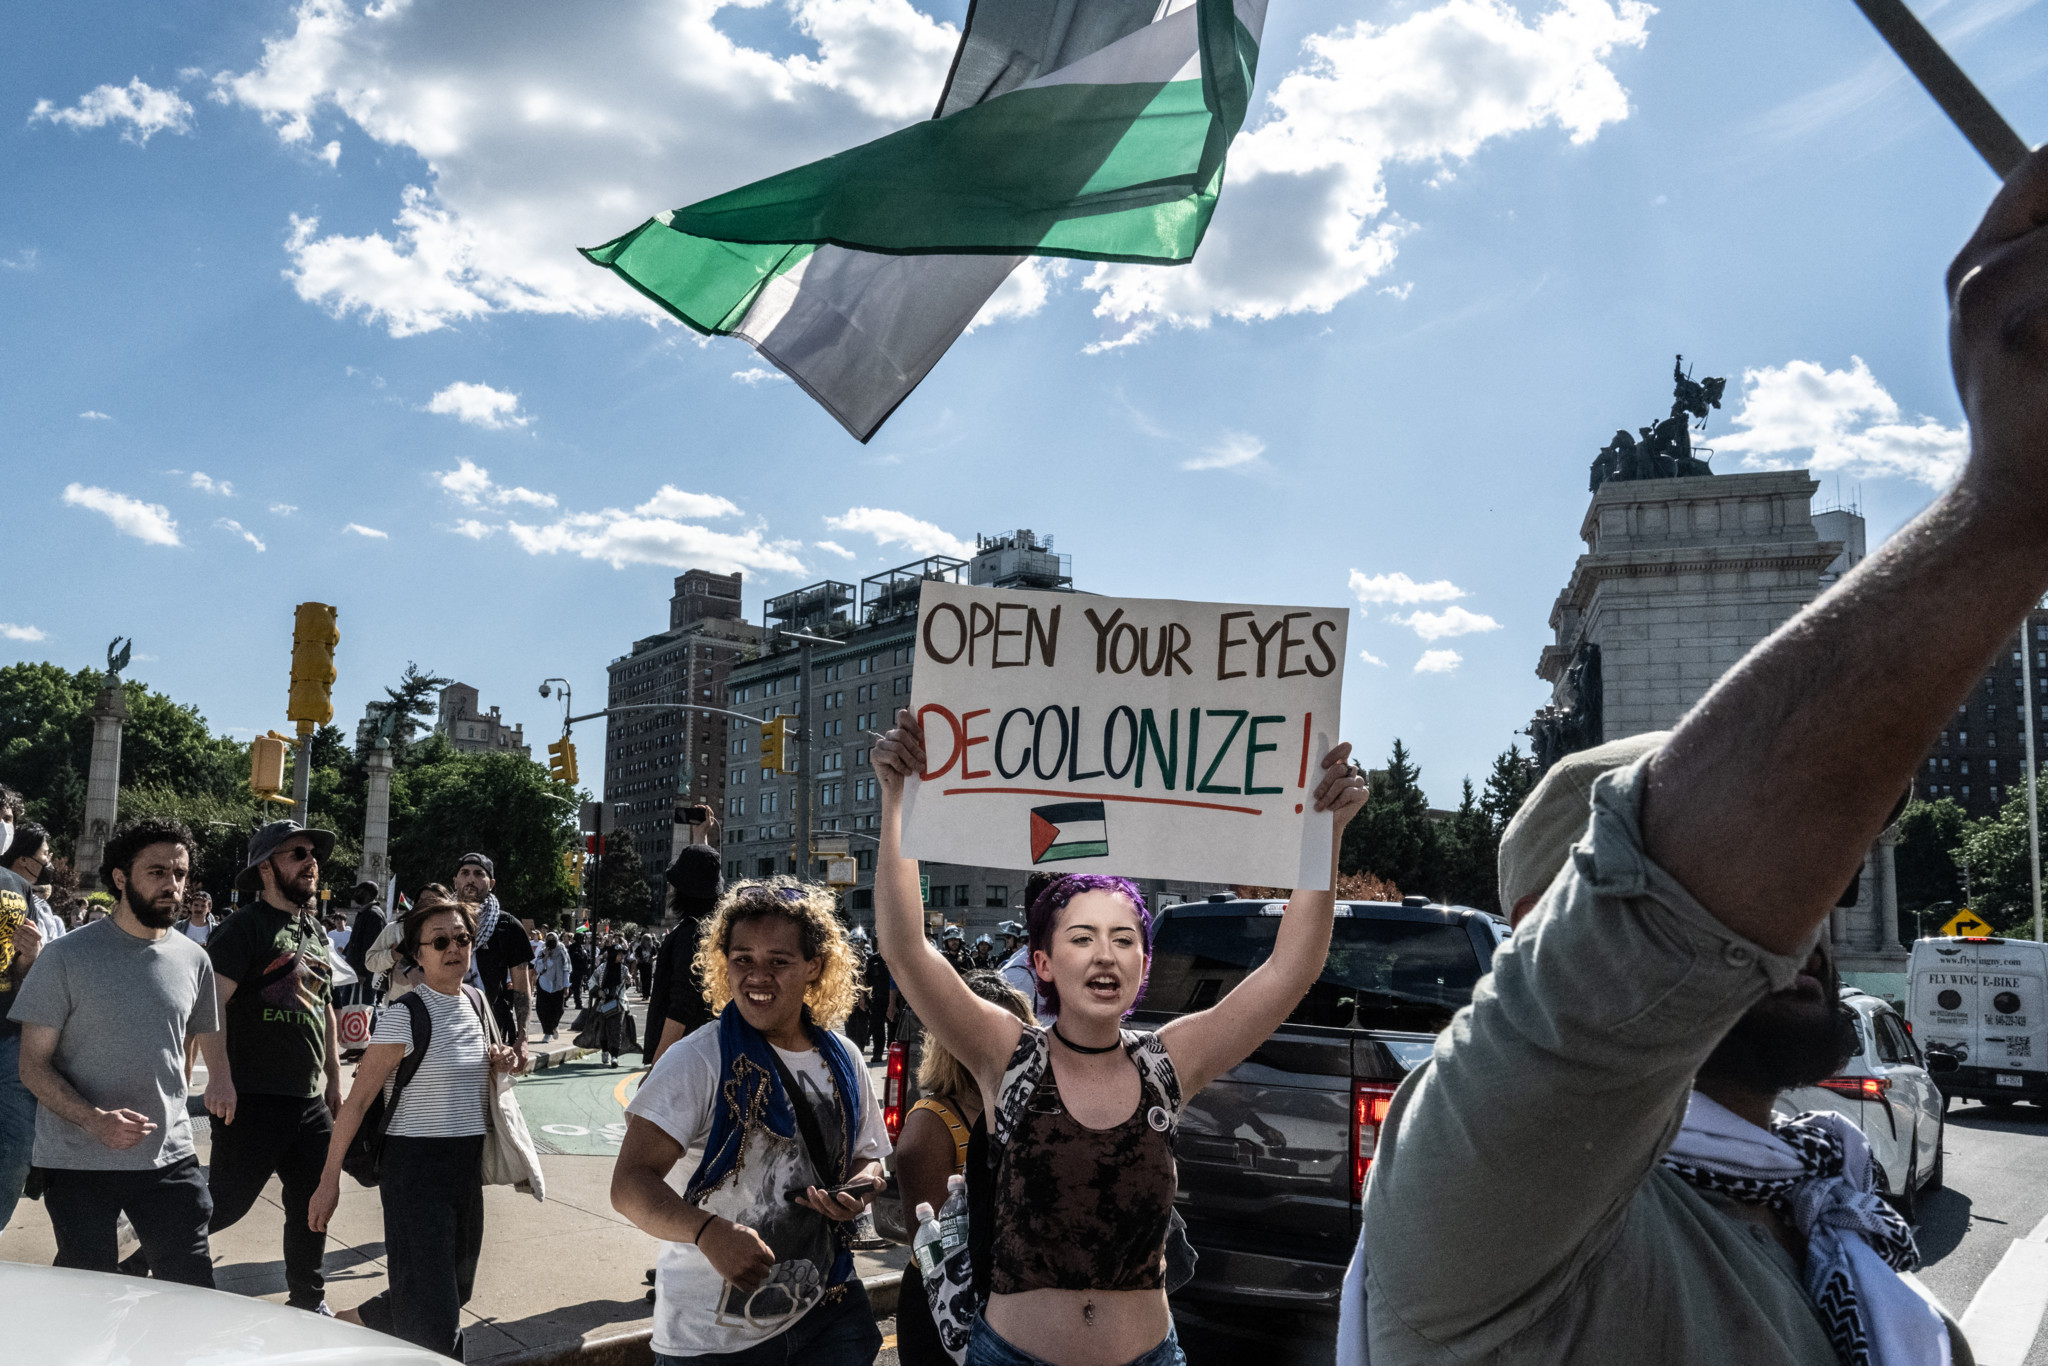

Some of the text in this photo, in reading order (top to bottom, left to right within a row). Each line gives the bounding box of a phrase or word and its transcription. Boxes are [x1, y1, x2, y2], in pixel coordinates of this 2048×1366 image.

[922, 601, 1338, 681] OPEN YOUR EYES
[917, 703, 1313, 815] DECOLONIZE!
[1929, 974, 2020, 988] FLY WING E-BIKE
[263, 1008, 292, 1023] EAT
